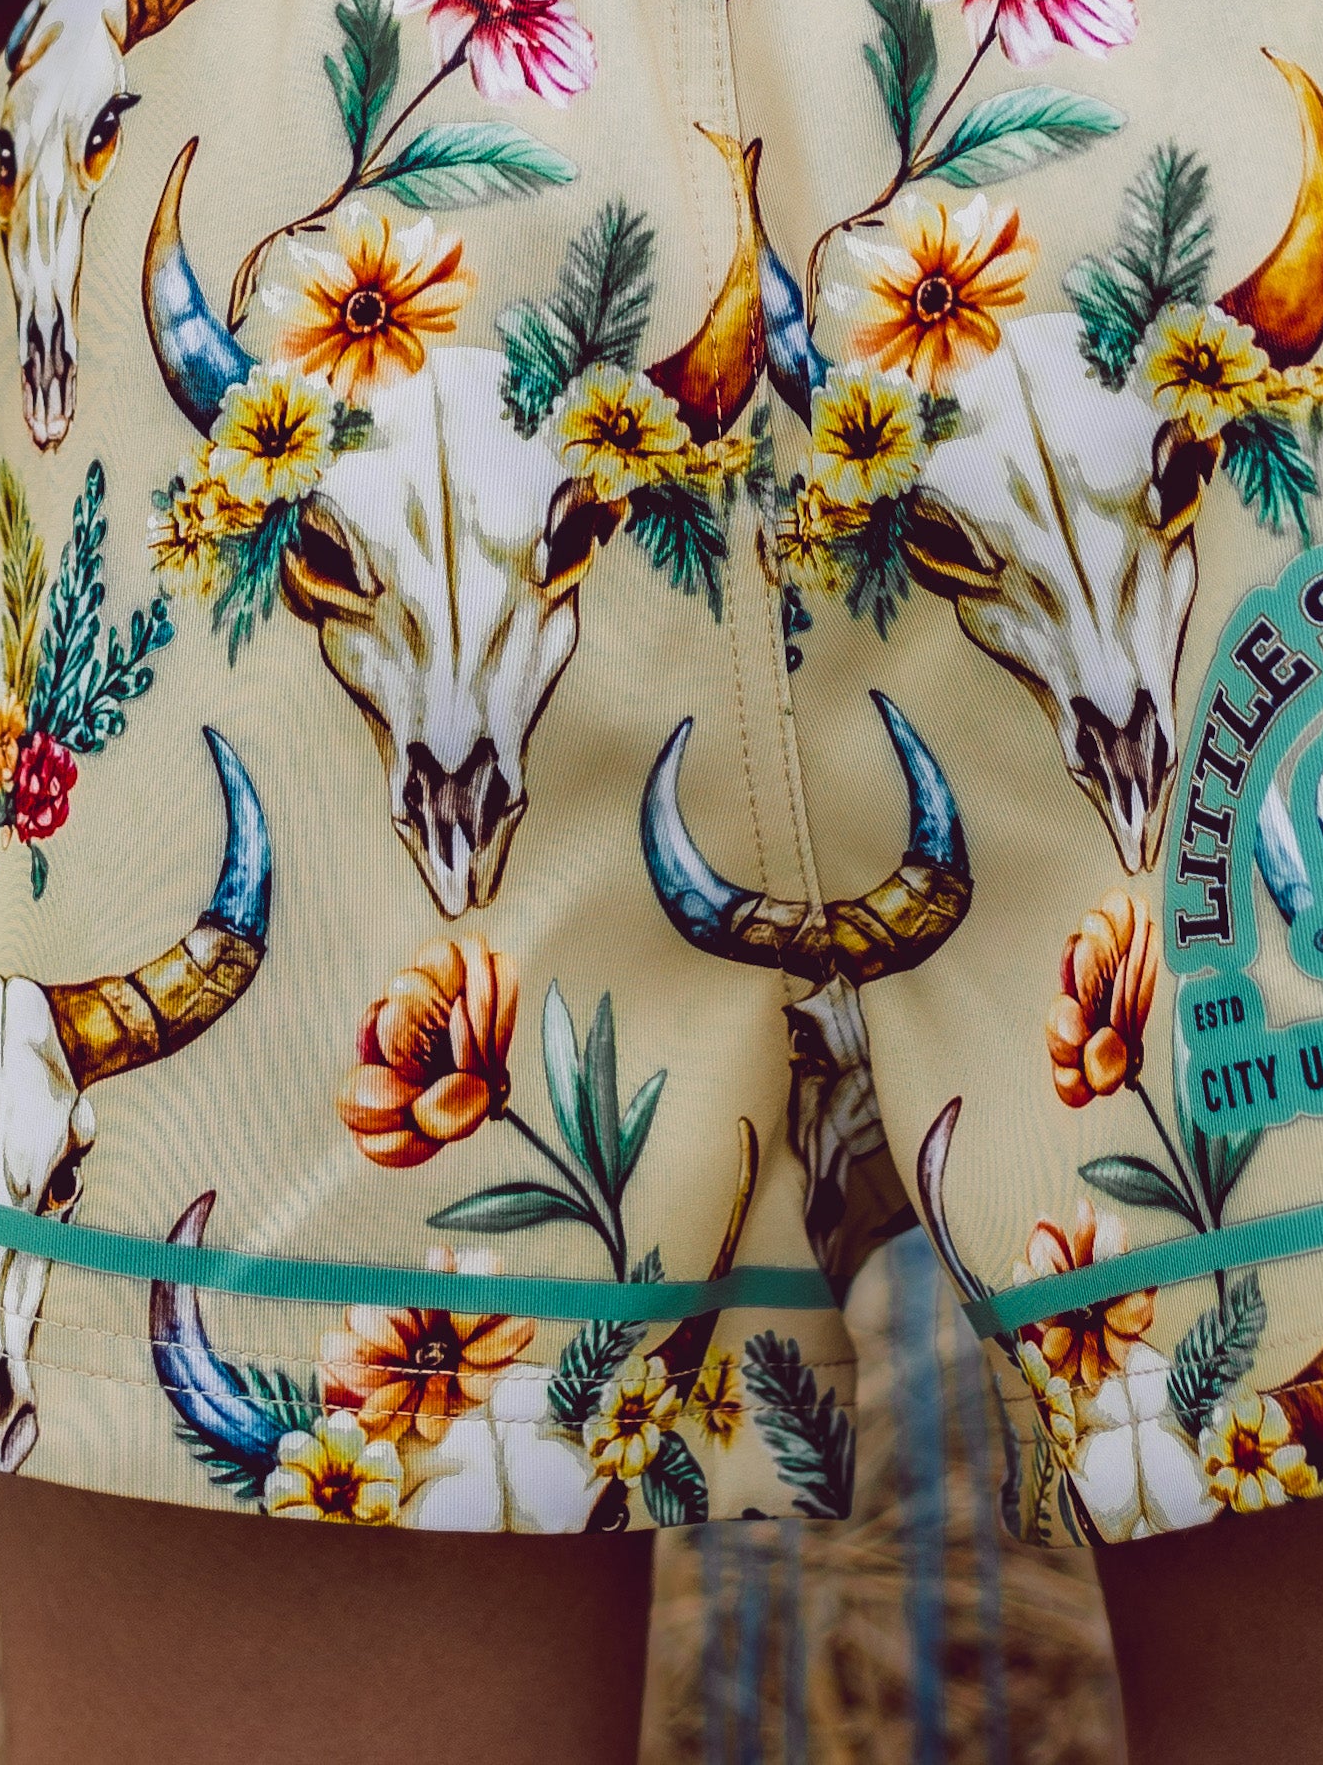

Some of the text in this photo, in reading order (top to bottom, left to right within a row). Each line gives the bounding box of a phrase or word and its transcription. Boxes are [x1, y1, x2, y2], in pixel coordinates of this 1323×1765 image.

[1175, 614, 1323, 948] LITTLE
[1194, 996, 1246, 1032] ESTD
[1202, 1054, 1277, 1113] CITY
